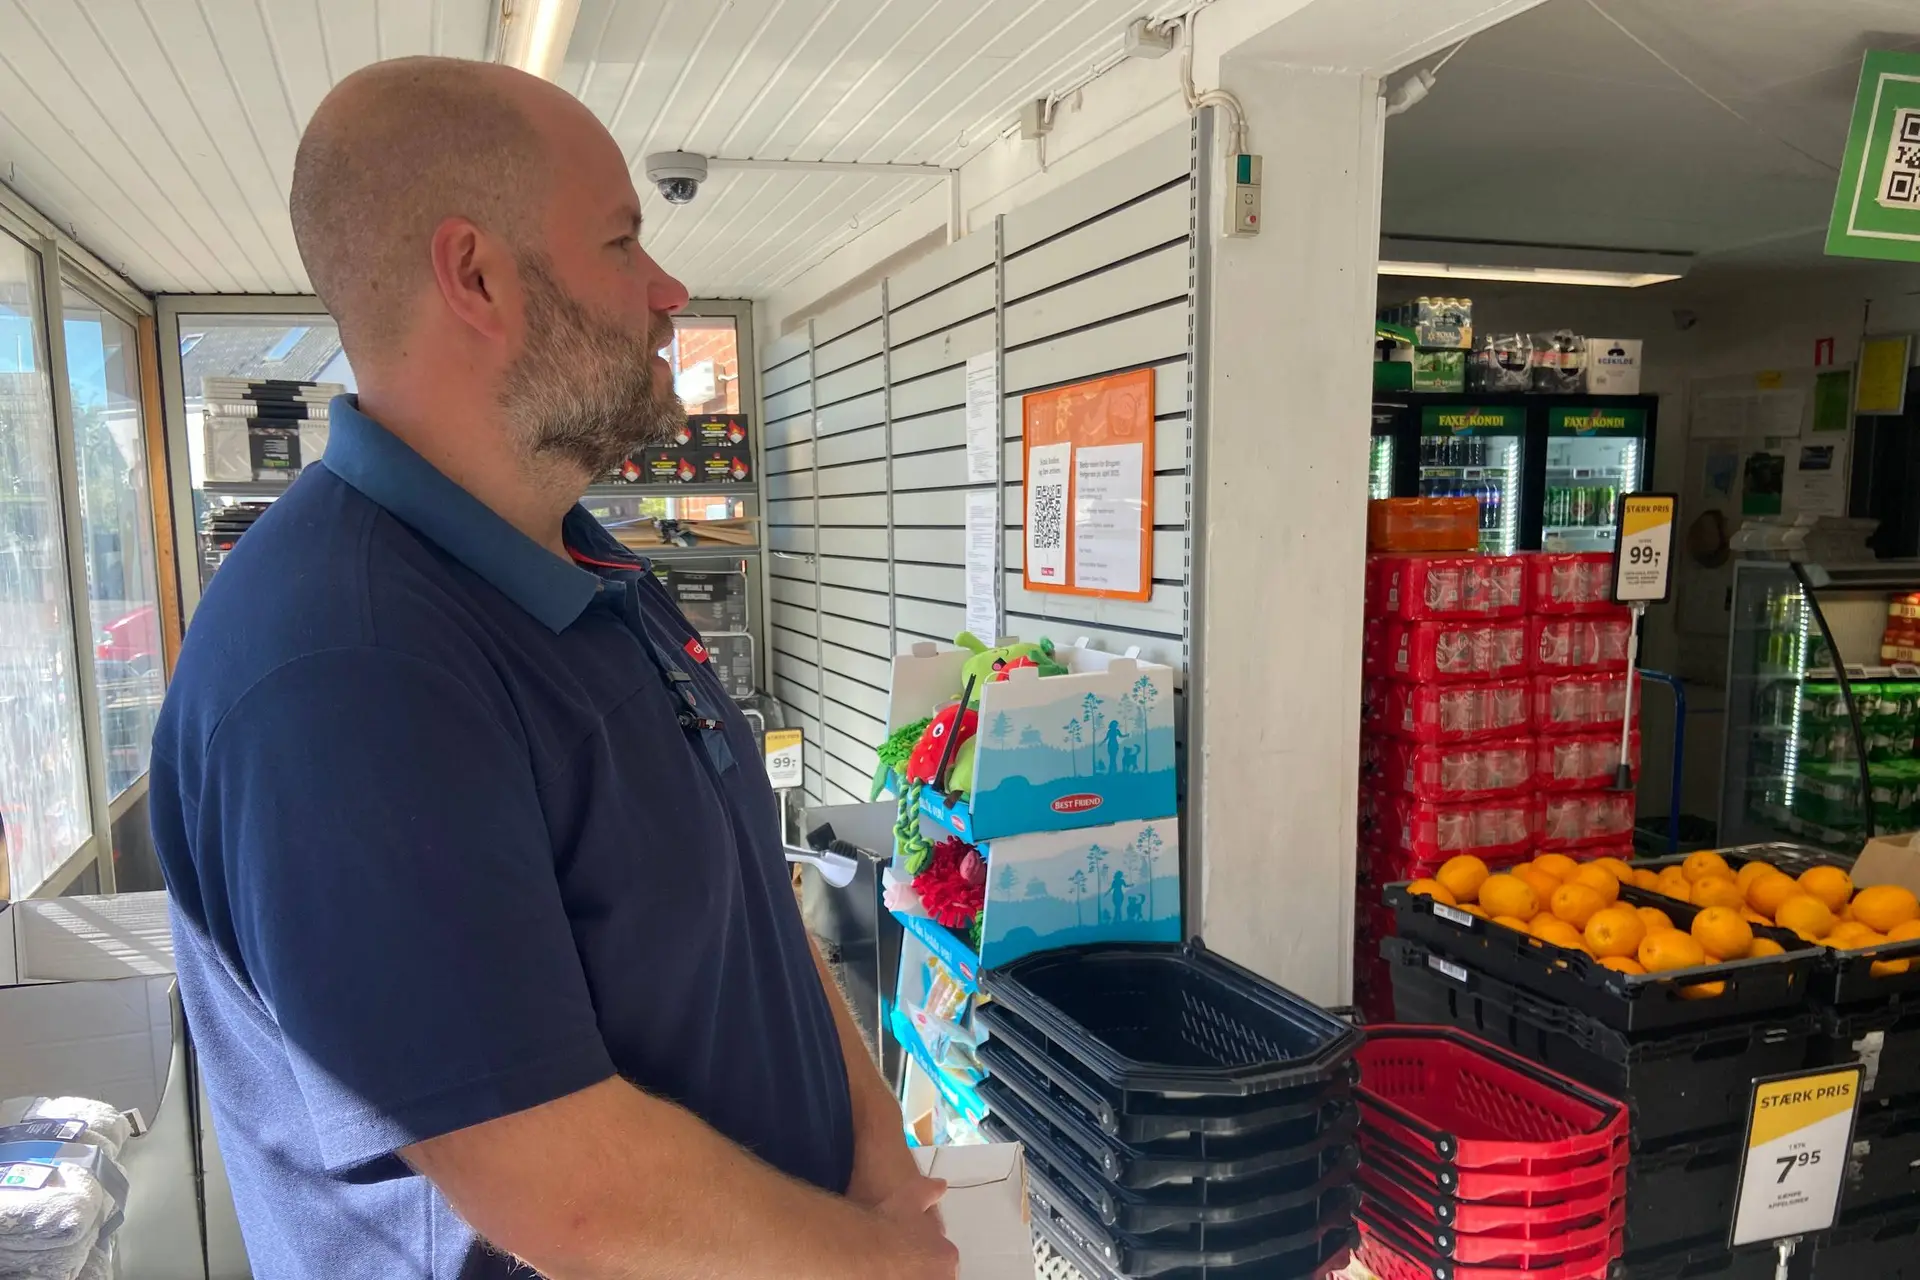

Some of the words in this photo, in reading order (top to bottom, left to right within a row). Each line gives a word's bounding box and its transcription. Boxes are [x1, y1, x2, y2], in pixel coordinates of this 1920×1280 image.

[1439, 415, 1465, 426] FAXE
[1470, 415, 1504, 426] KONDI
[1564, 416, 1589, 427] FAXE
[1593, 417, 1625, 428] KONDI
[1626, 505, 1651, 513] STÆRK
[1653, 504, 1669, 513] PRIS
[1055, 801, 1073, 810] BEST
[1074, 798, 1100, 807] FRIEND
[1760, 1090, 1812, 1109] STÆRK
[1816, 1083, 1850, 1100] PRIS
